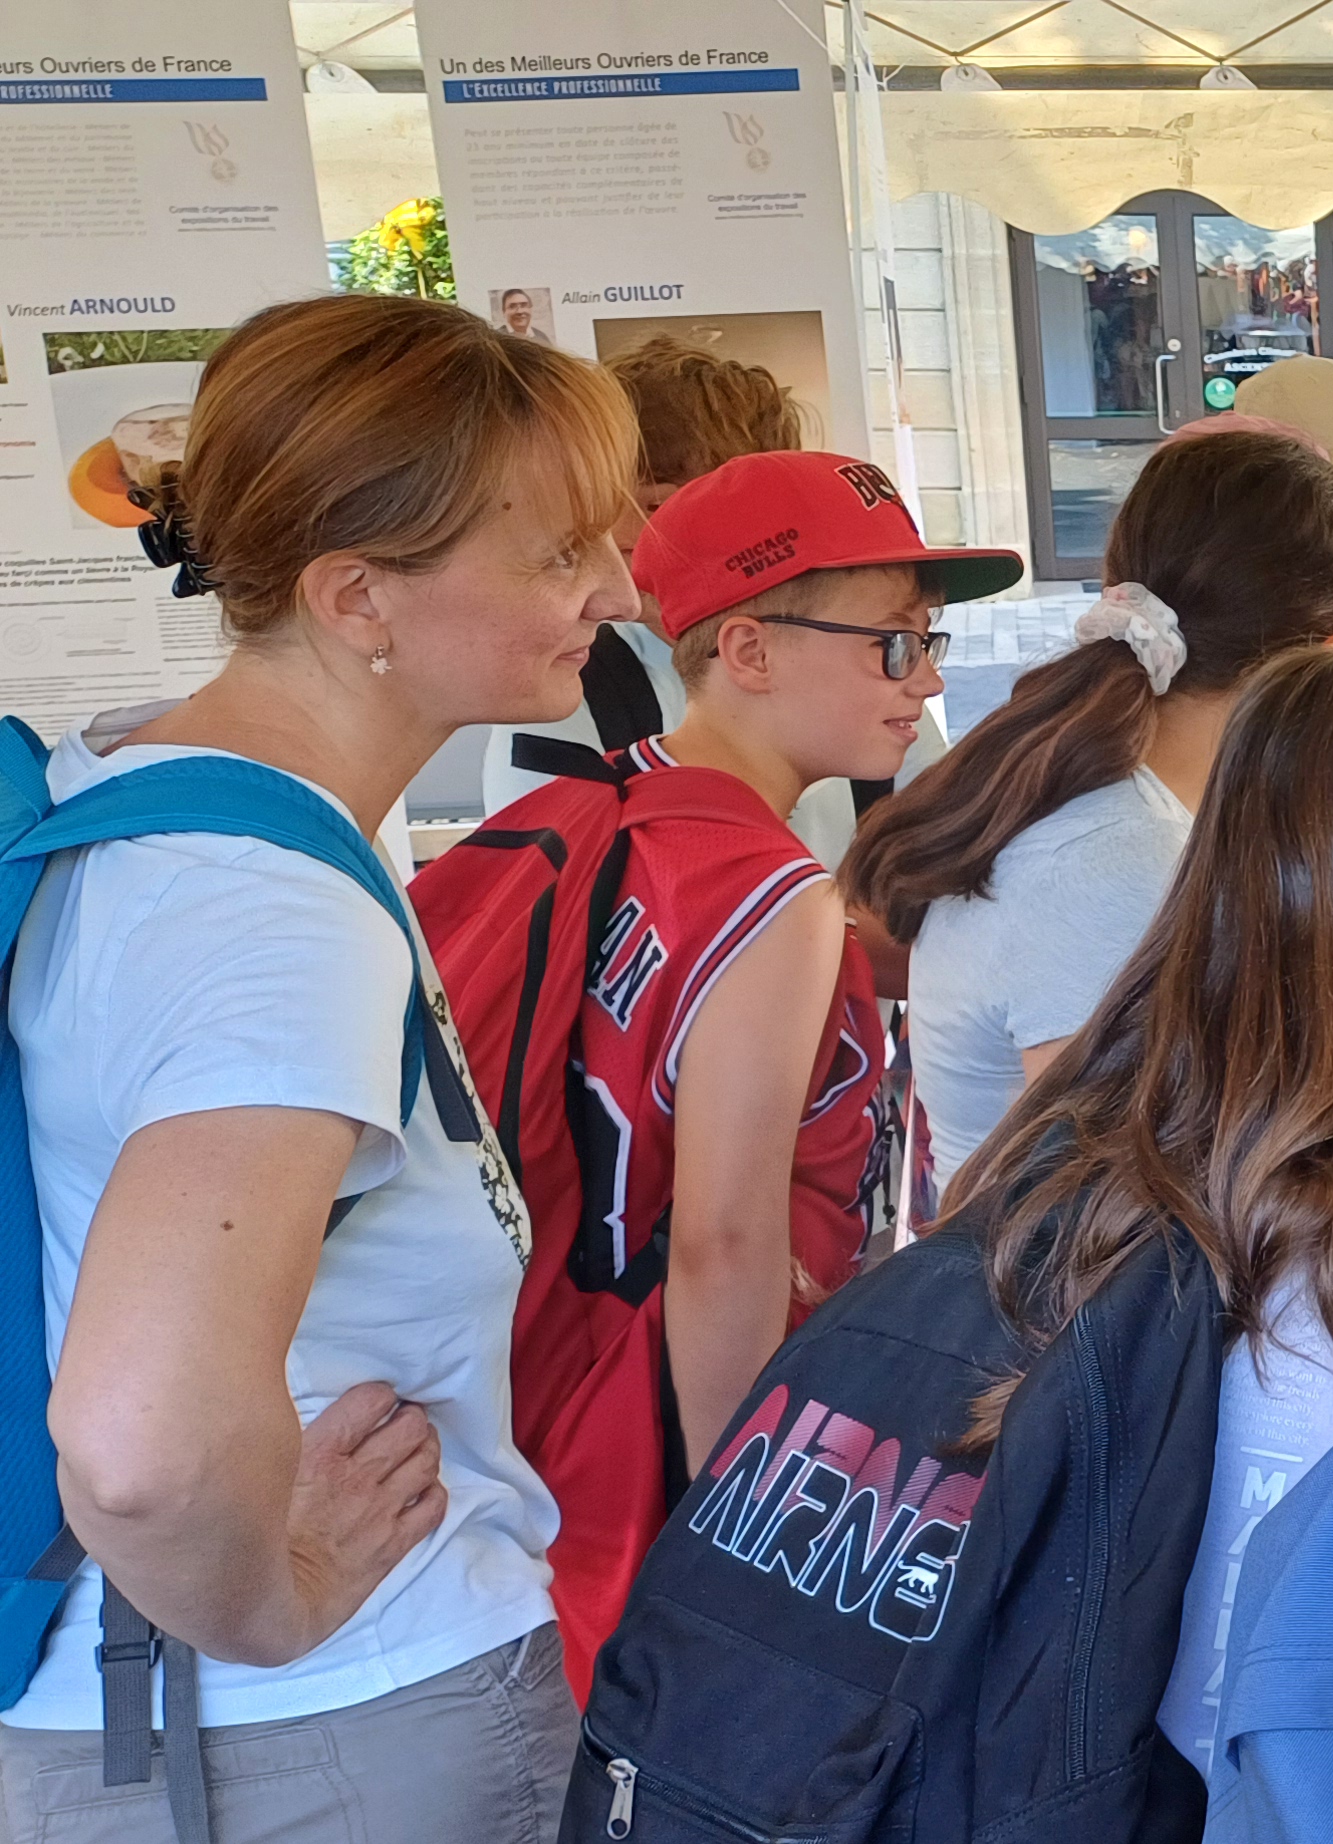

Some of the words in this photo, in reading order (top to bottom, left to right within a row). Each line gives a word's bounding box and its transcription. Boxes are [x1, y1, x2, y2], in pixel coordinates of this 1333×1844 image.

[0, 60, 34, 74] urs
[40, 57, 126, 74] Ouvriers
[132, 57, 156, 72] de
[163, 55, 232, 72] France
[440, 58, 467, 75] Un
[473, 57, 505, 73] des
[511, 55, 591, 72] Meilleurs
[597, 52, 673, 69] Ouvriers
[678, 50, 701, 66] de
[706, 48, 769, 65] France
[552, 78, 662, 95] PROFESSIONNELLE
[561, 291, 601, 304] Allain
[604, 284, 685, 303] GUILLOT
[7, 304, 66, 317] Vincent
[69, 297, 176, 315] ARNOULD
[725, 528, 799, 572] CHICAGO
[741, 543, 796, 579] BULLS
